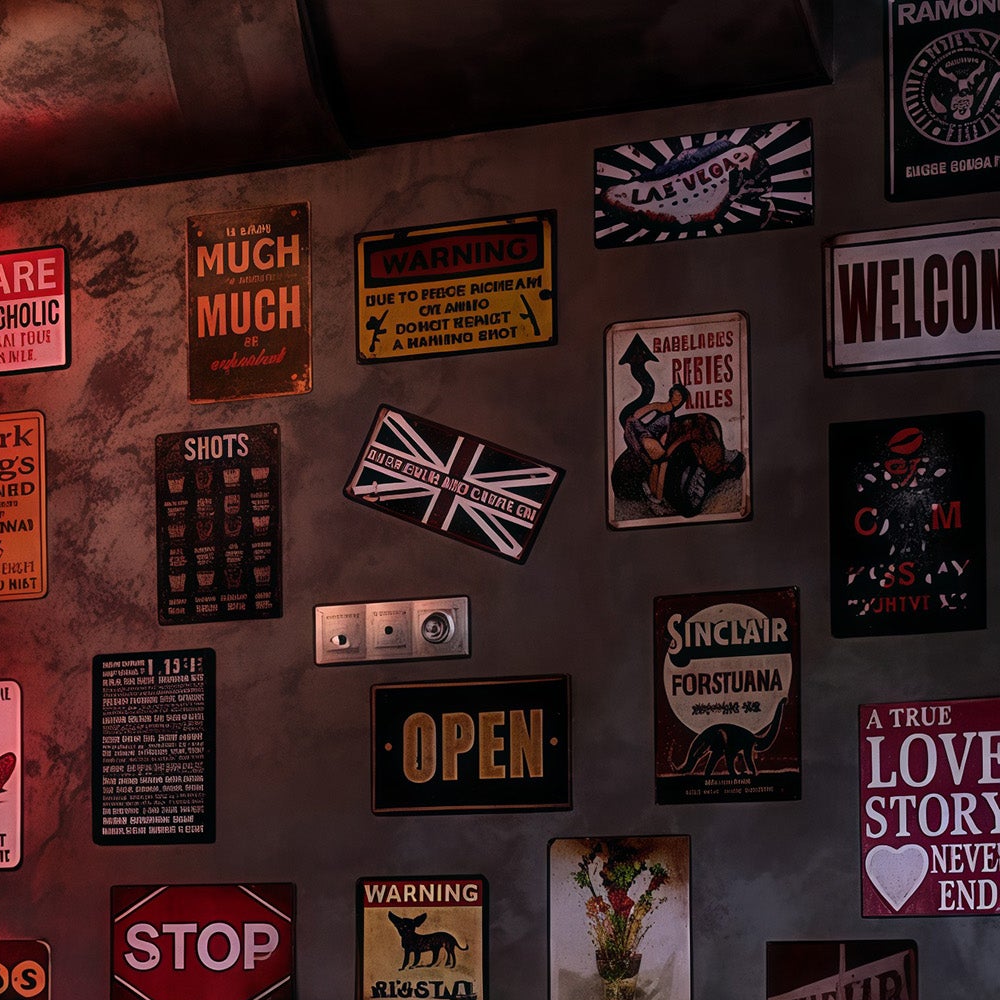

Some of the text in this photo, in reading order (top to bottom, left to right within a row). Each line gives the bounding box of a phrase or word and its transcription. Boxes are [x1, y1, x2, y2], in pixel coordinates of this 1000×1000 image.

[898, 0, 1000, 26] RAMON
[382, 238, 529, 274] WARNING
[197, 285, 301, 338] MUCH
[399, 290, 418, 303] TO
[184, 433, 249, 461] SHOTS
[667, 613, 790, 655] SINCLAIR
[866, 706, 952, 730] A TRUE
[402, 708, 544, 784] OPEN
[866, 731, 1000, 788] LOVE
[865, 792, 1000, 839] STORY
[930, 842, 1000, 874] NEVE
[364, 883, 478, 904] WARNING
[938, 879, 1000, 911] END
[124, 922, 279, 971] STOP
